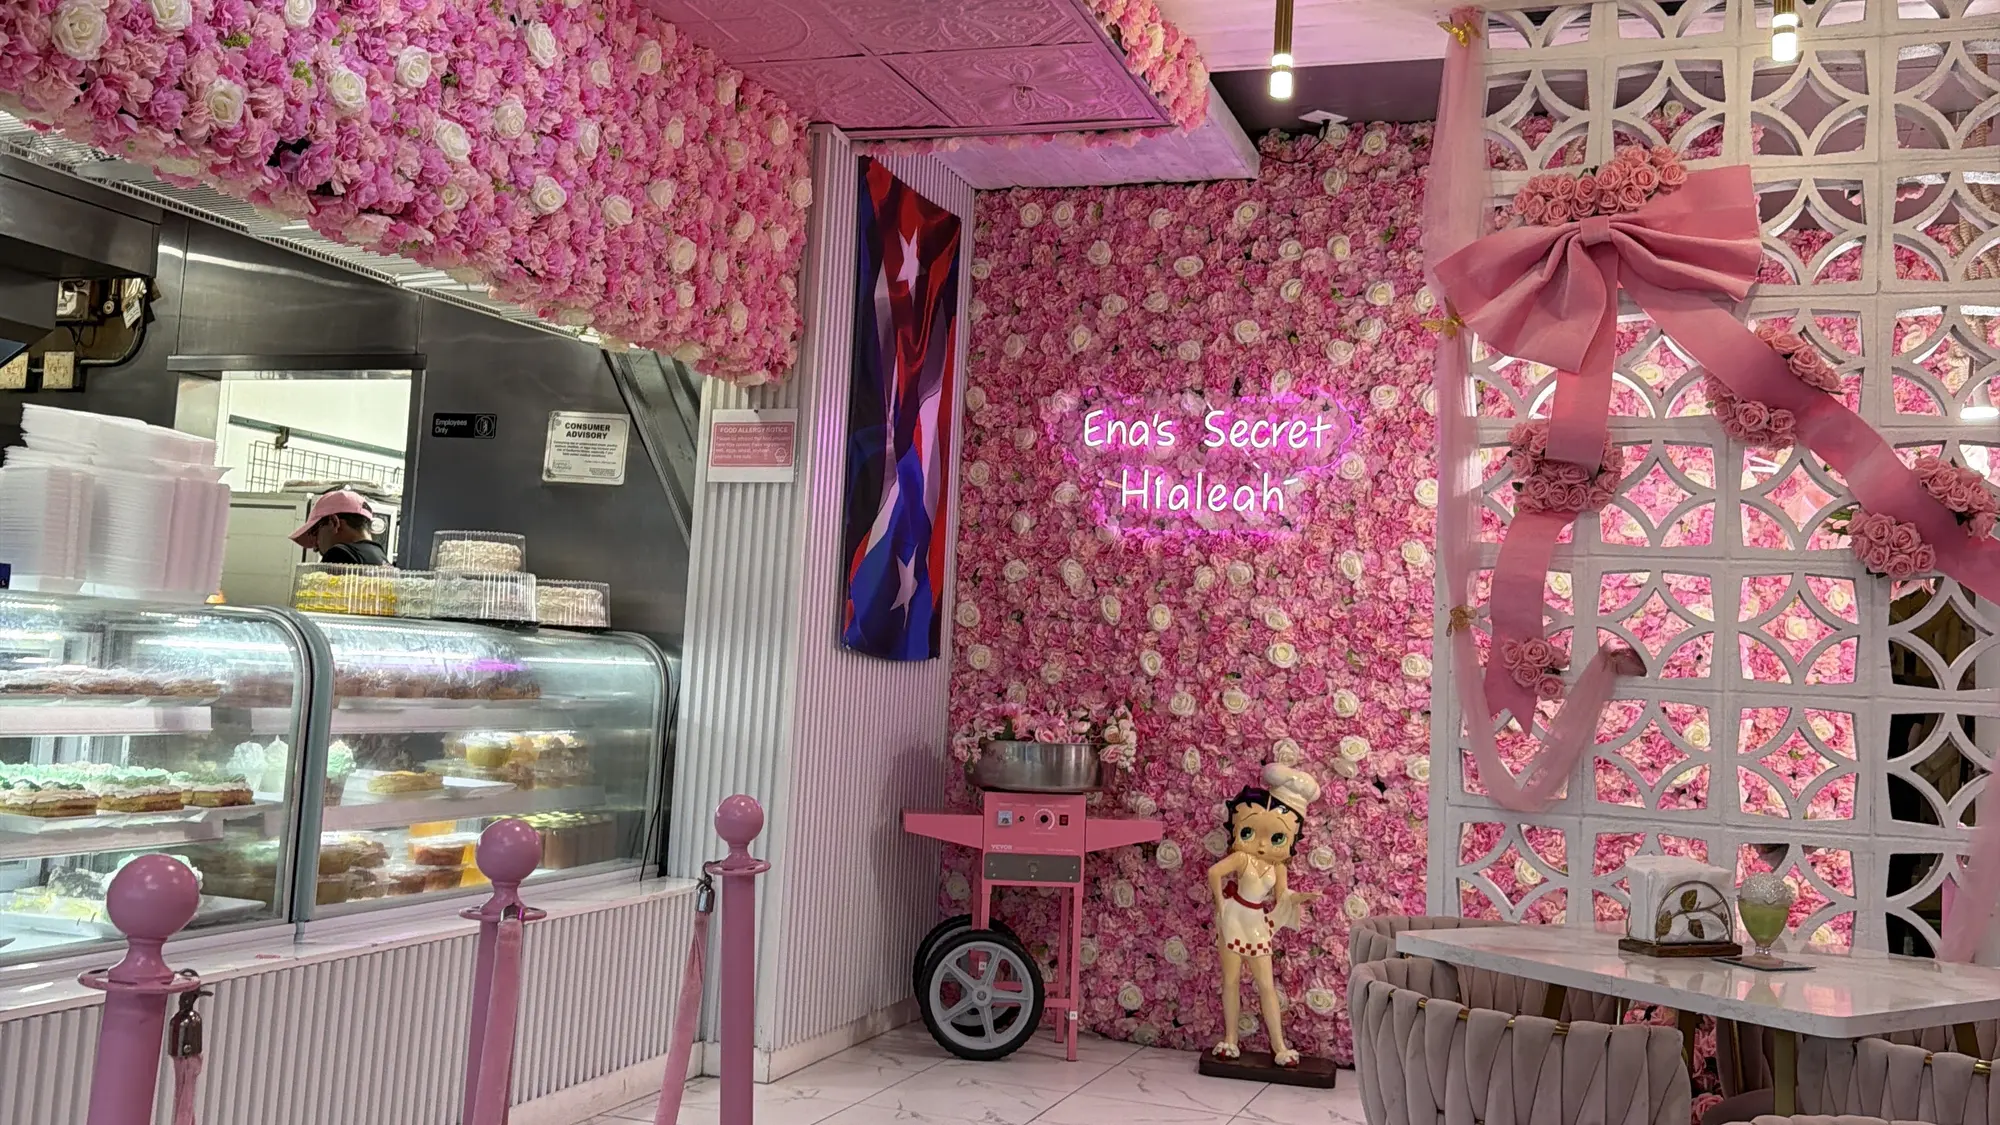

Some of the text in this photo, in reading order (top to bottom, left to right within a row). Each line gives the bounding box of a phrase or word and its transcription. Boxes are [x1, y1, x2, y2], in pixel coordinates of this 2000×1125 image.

[435, 418, 468, 427] Employees
[564, 422, 611, 432] CONSUMER
[434, 427, 449, 435] Only
[1083, 409, 1333, 449] Ena's Secret
[565, 430, 608, 440] ADVISORY
[1120, 469, 1286, 512] Hialeah
